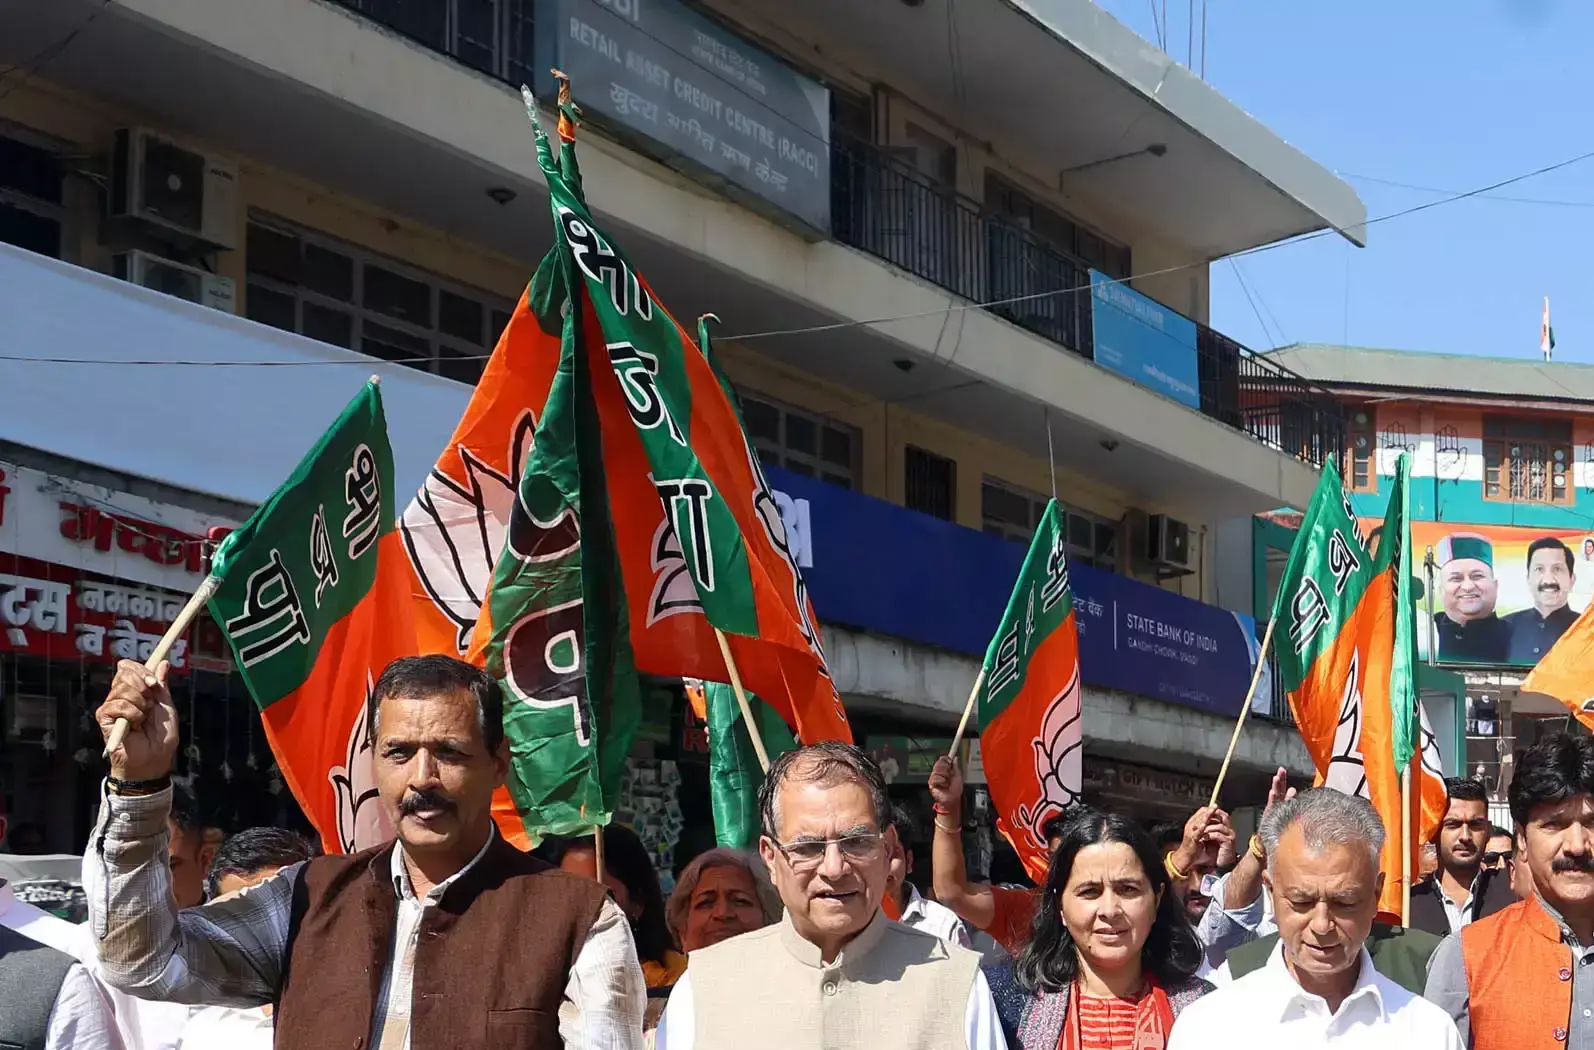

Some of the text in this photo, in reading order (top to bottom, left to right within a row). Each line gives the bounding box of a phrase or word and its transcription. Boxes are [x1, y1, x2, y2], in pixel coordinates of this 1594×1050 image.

[569, 16, 622, 66] RETAIL
[674, 75, 722, 121] CREDIT
[725, 104, 776, 150] CENTRE
[1126, 612, 1218, 653] STATE BANK OF INDIA
